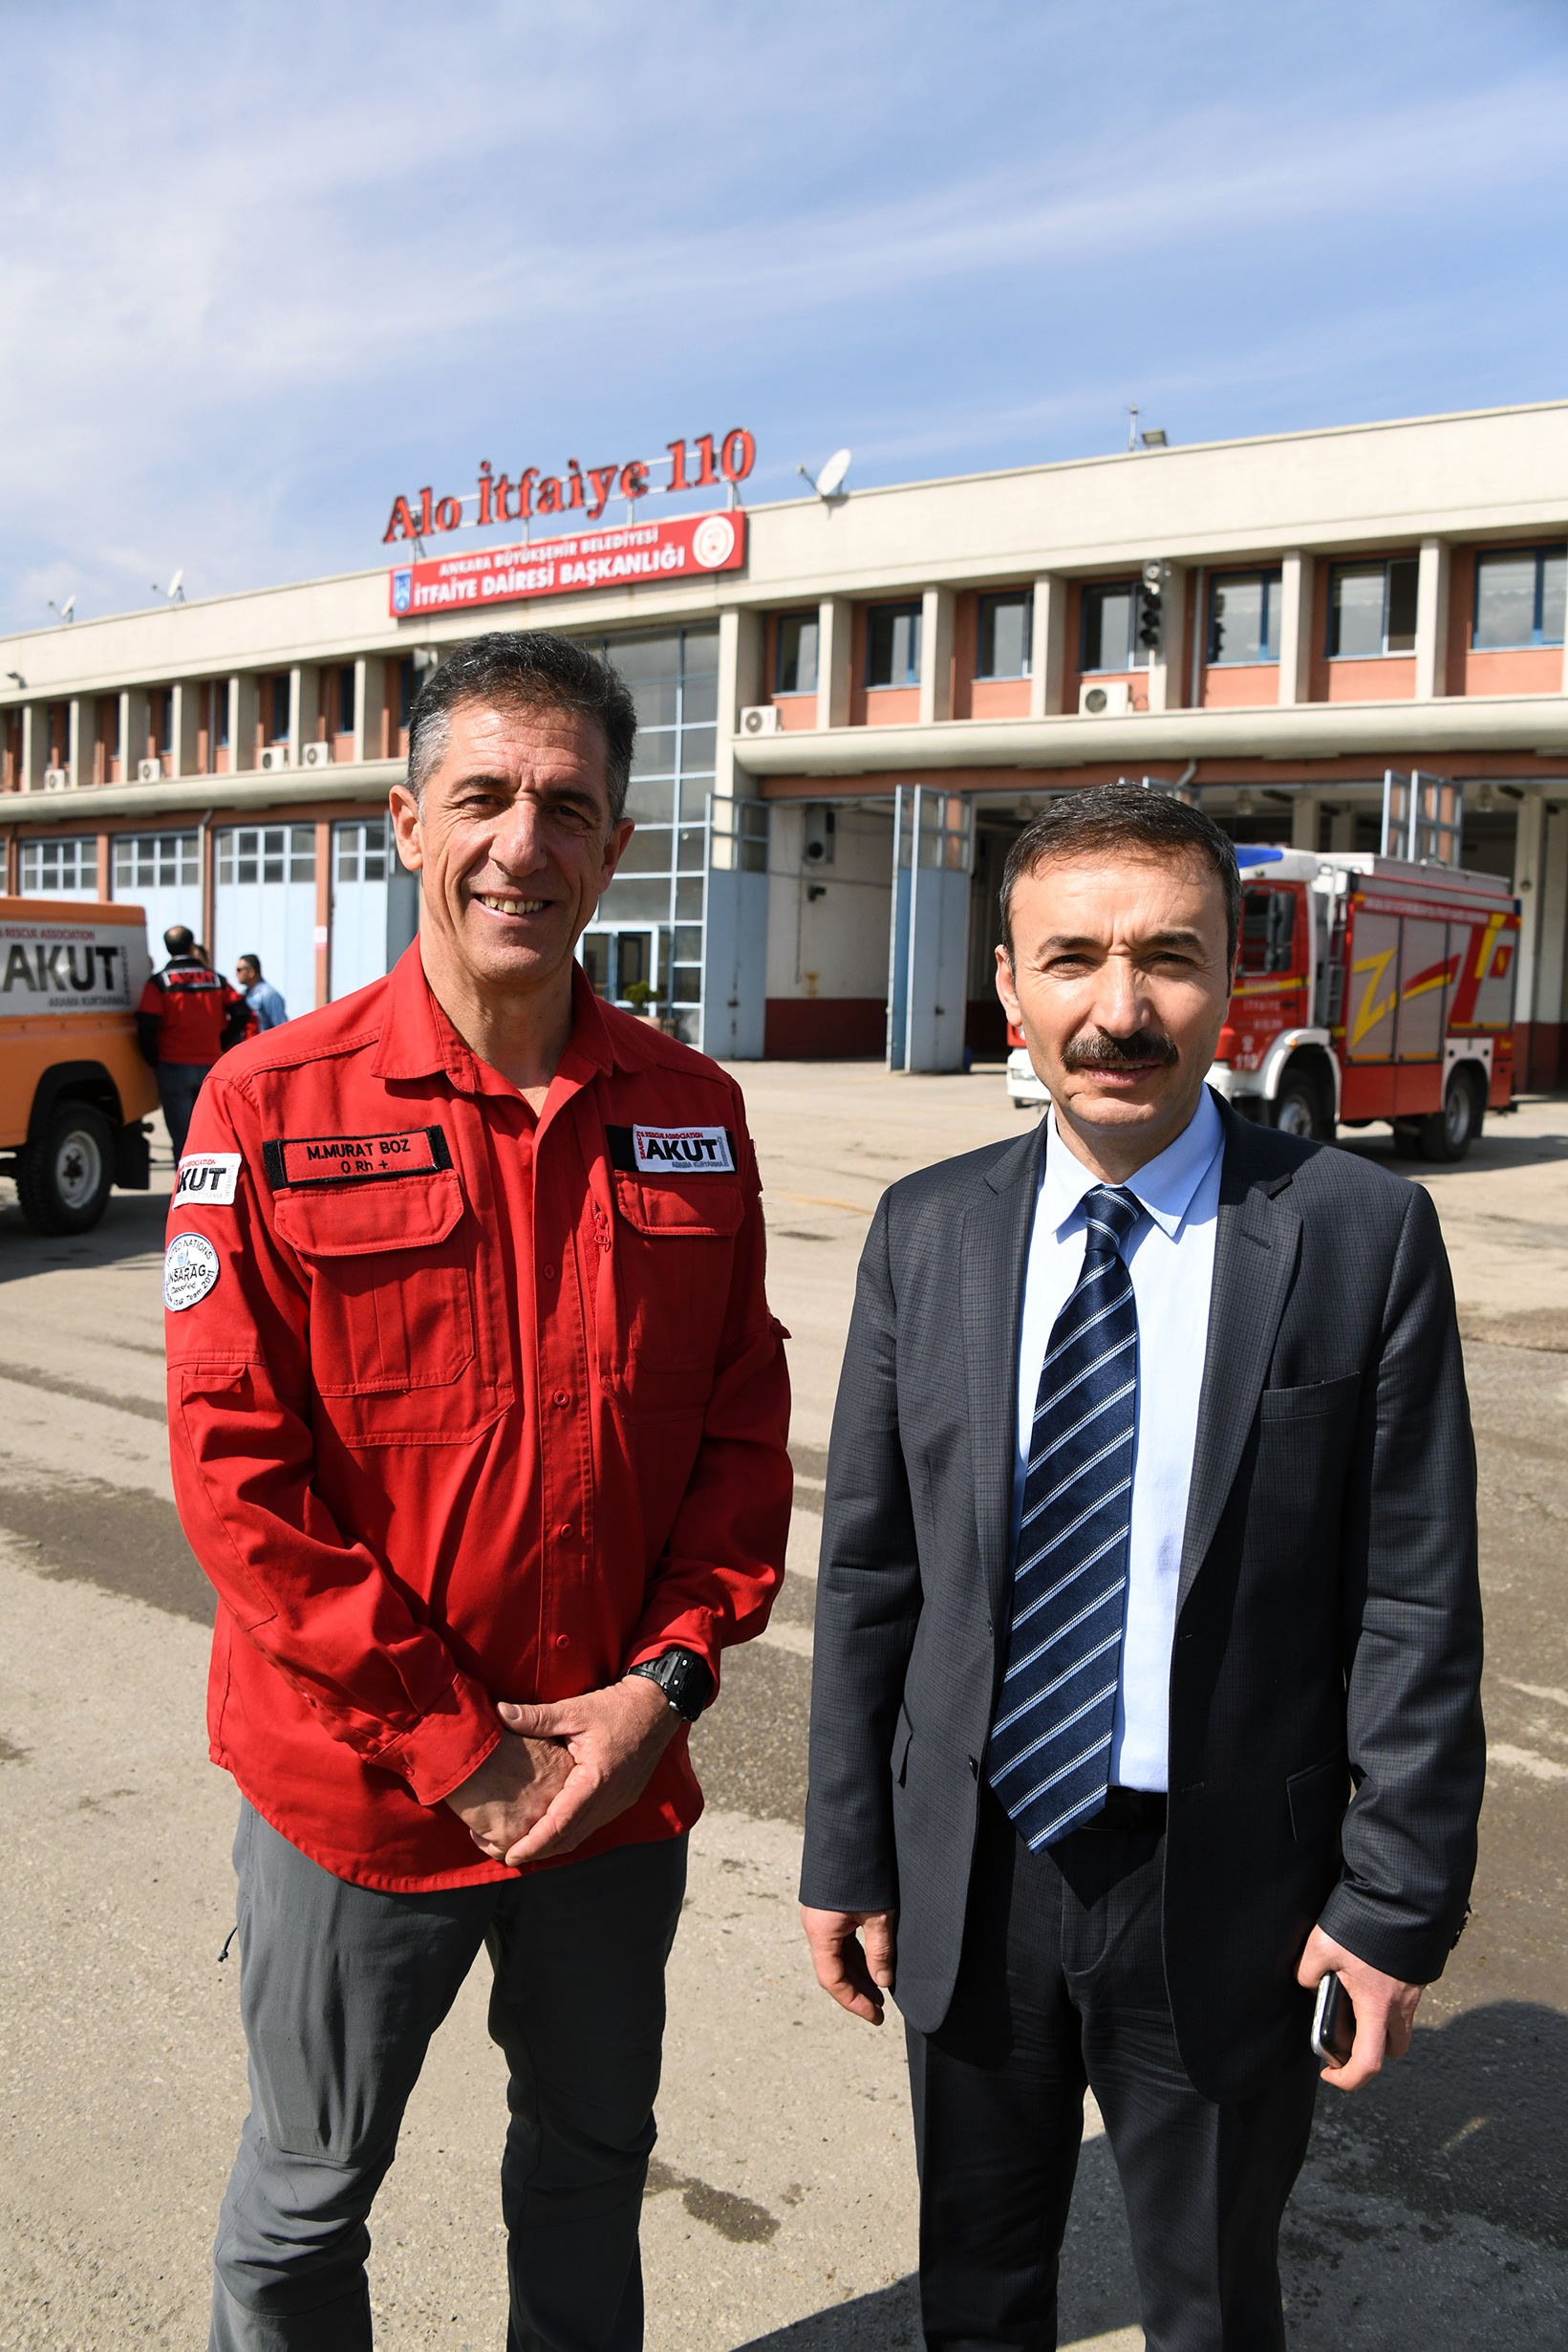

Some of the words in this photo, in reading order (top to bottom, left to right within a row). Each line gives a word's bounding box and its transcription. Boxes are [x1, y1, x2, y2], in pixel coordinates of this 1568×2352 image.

[383, 487, 461, 543] Alo
[667, 427, 757, 491] 110
[439, 555, 491, 577] ANKARA
[493, 539, 577, 568] BÜYÜKŞEHİR
[580, 526, 659, 554] BELEDİYESİ
[414, 577, 477, 606] İTFAİYE
[482, 562, 554, 596] DAİRESİ
[560, 543, 685, 586] BAŞKANLIĞI
[2, 944, 118, 992] AKUT
[307, 1143, 374, 1160] M.MURAT
[379, 1138, 411, 1154] BOZ
[646, 1139, 718, 1162] AKUT
[355, 1160, 374, 1172] Rh
[183, 1239, 213, 1260] NATIONS
[201, 1269, 216, 1289] 2011
